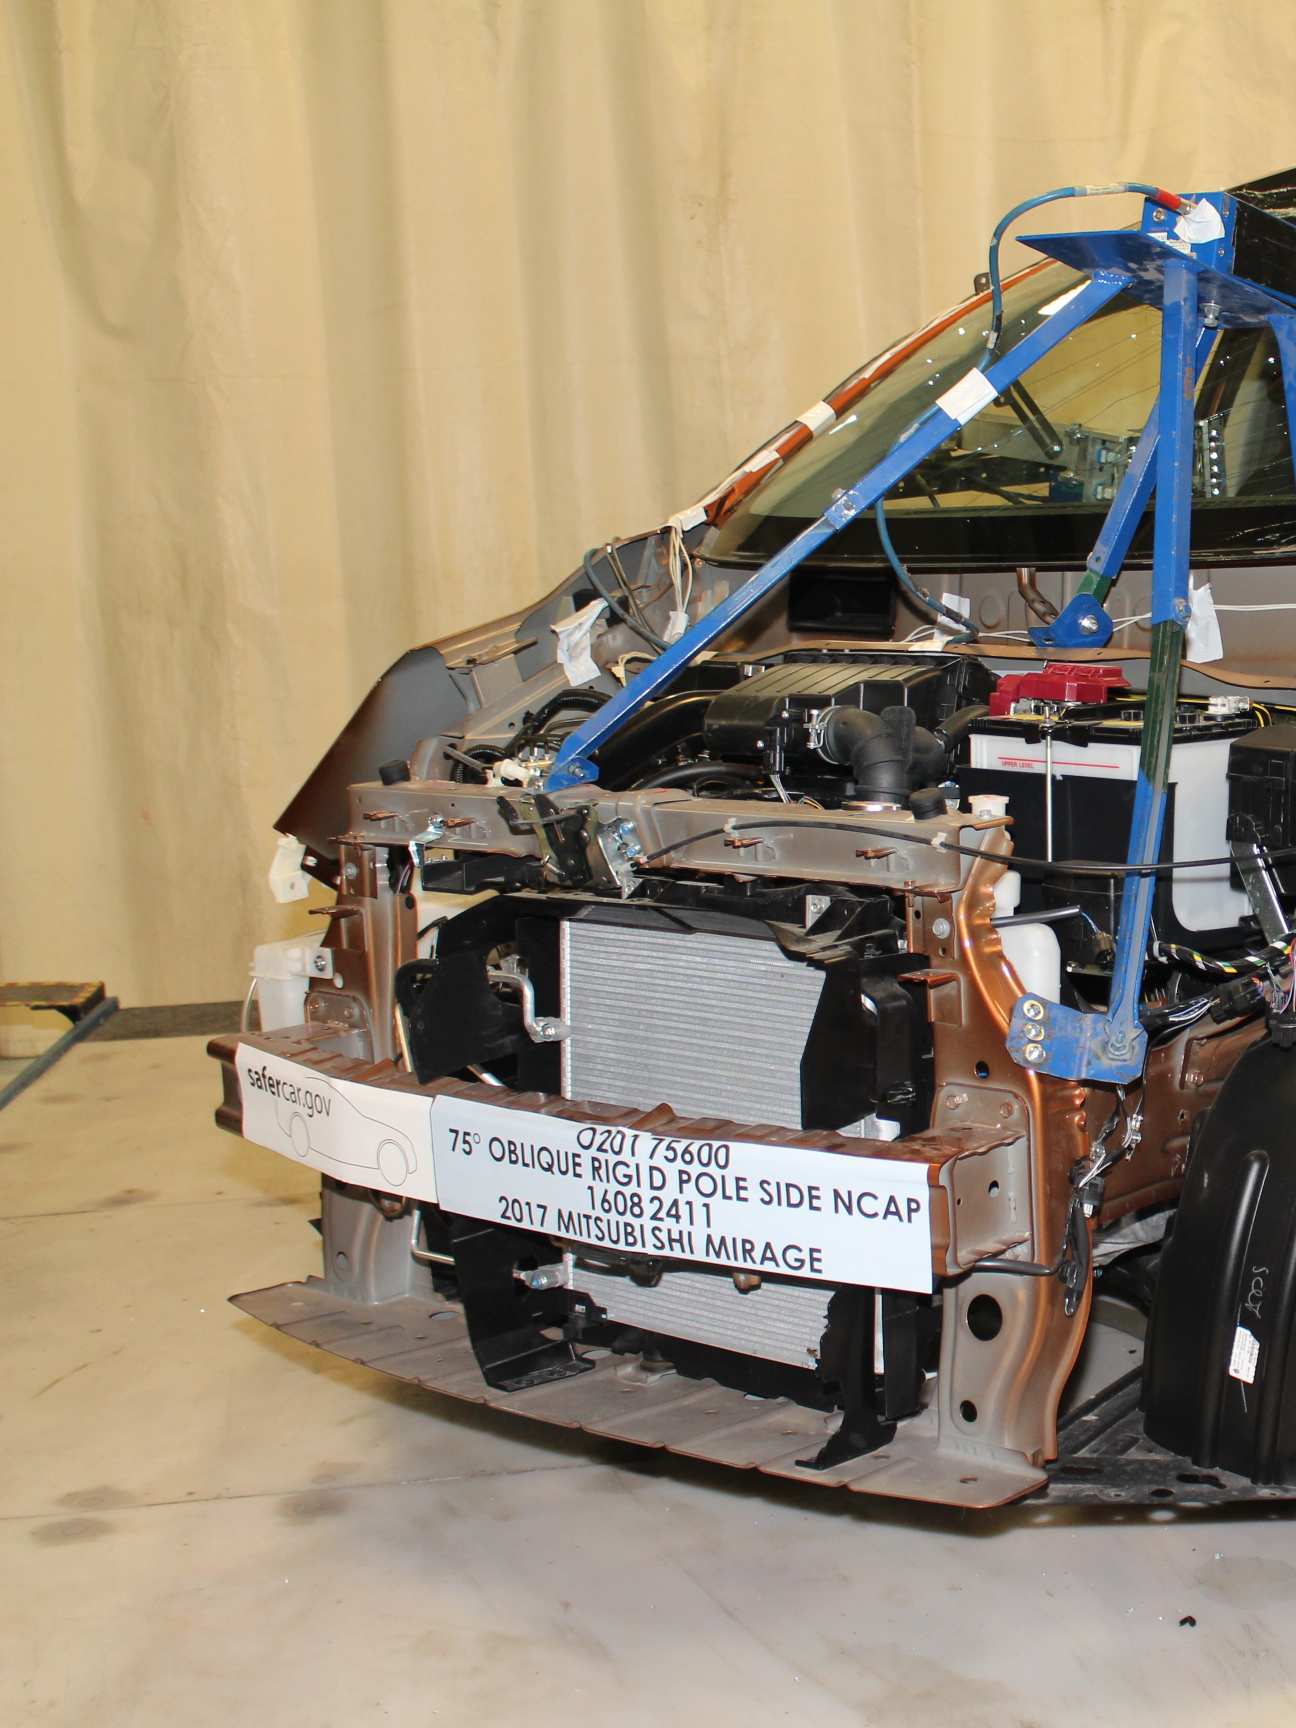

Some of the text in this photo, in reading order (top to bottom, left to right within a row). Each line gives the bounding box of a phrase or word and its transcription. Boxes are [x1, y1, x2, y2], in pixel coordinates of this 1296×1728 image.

[247, 1065, 332, 1118] safercar.gov
[488, 1136, 583, 1179] OBLIQUE
[591, 1156, 667, 1191] RIGID
[678, 1169, 749, 1203] POLE
[759, 1179, 822, 1212] SIDE
[833, 1188, 921, 1224] NCAP
[587, 1185, 712, 1229] 16082411
[499, 1195, 823, 1274] 2017 MITSUBISHI MIRAGE
